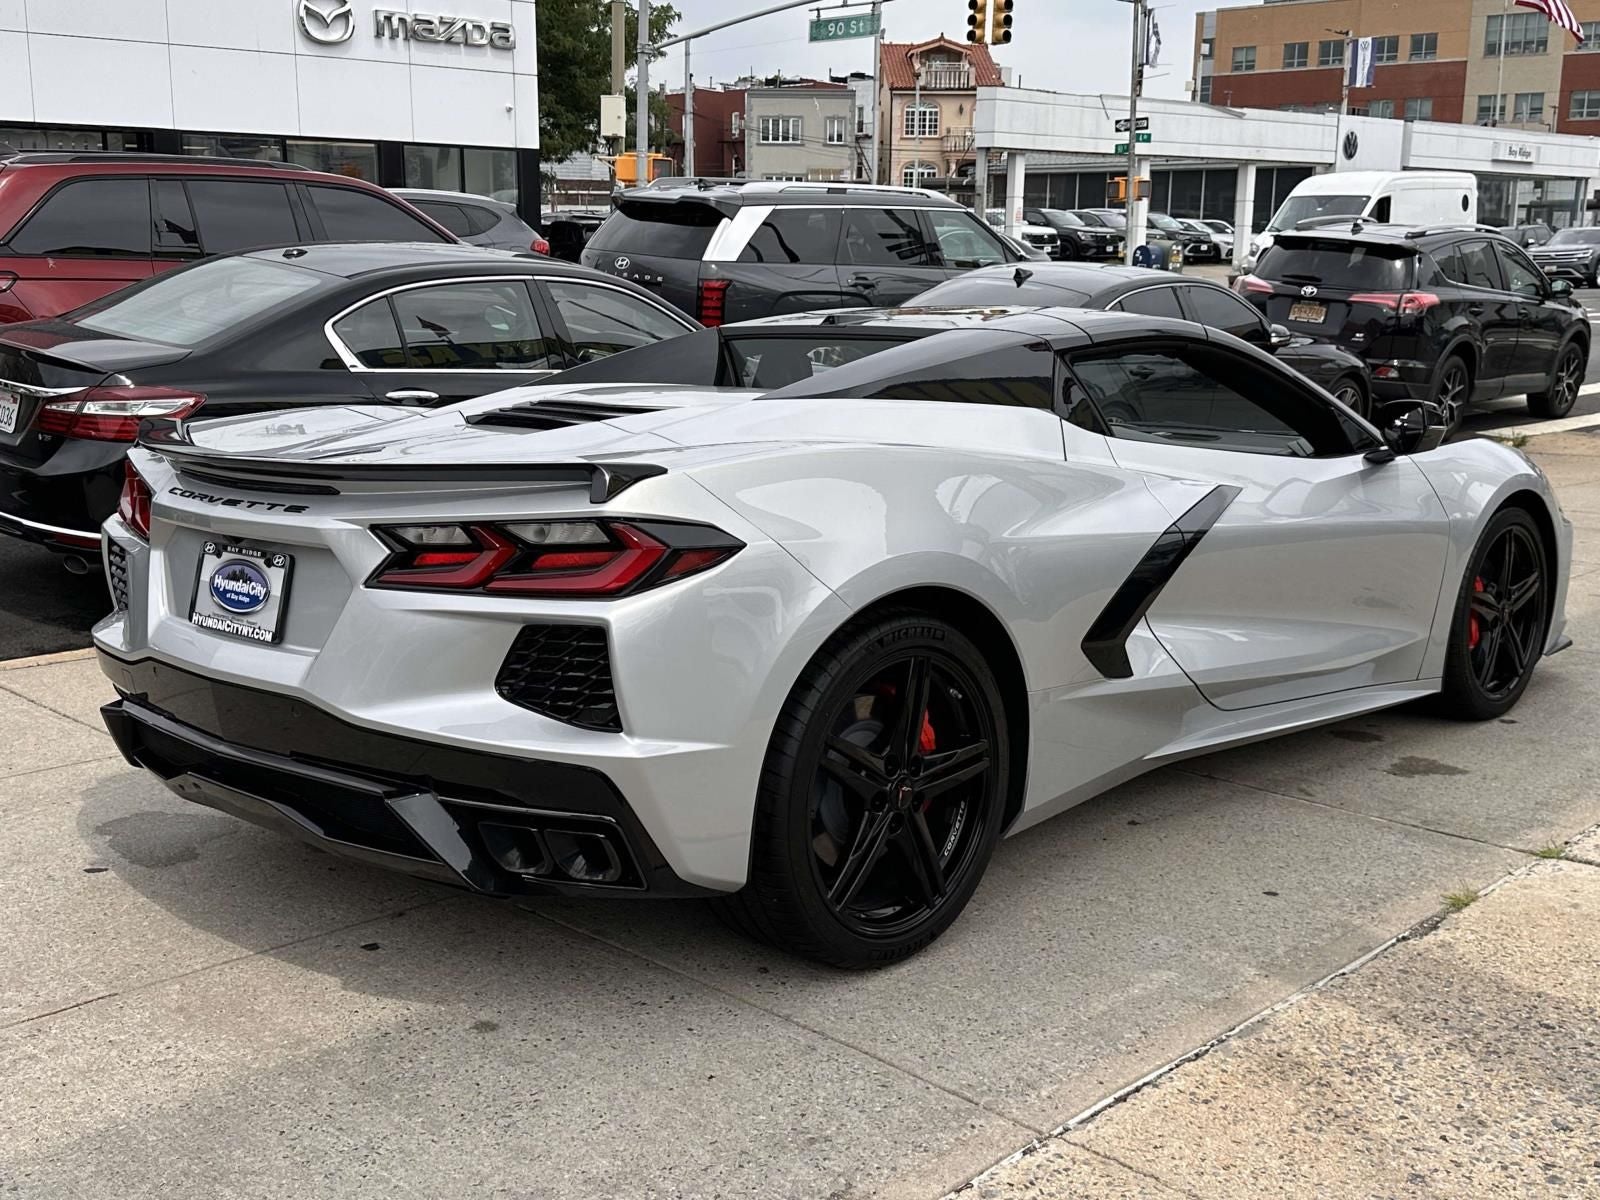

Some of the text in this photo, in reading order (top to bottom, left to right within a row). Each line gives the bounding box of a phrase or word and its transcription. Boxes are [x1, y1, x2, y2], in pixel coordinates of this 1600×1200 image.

[828, 20, 864, 37] 90 St
[0, 403, 16, 427] 036
[168, 486, 310, 514] CORVETTE
[227, 545, 262, 557] BAY RIDGE
[944, 800, 966, 857] CORVETTE
